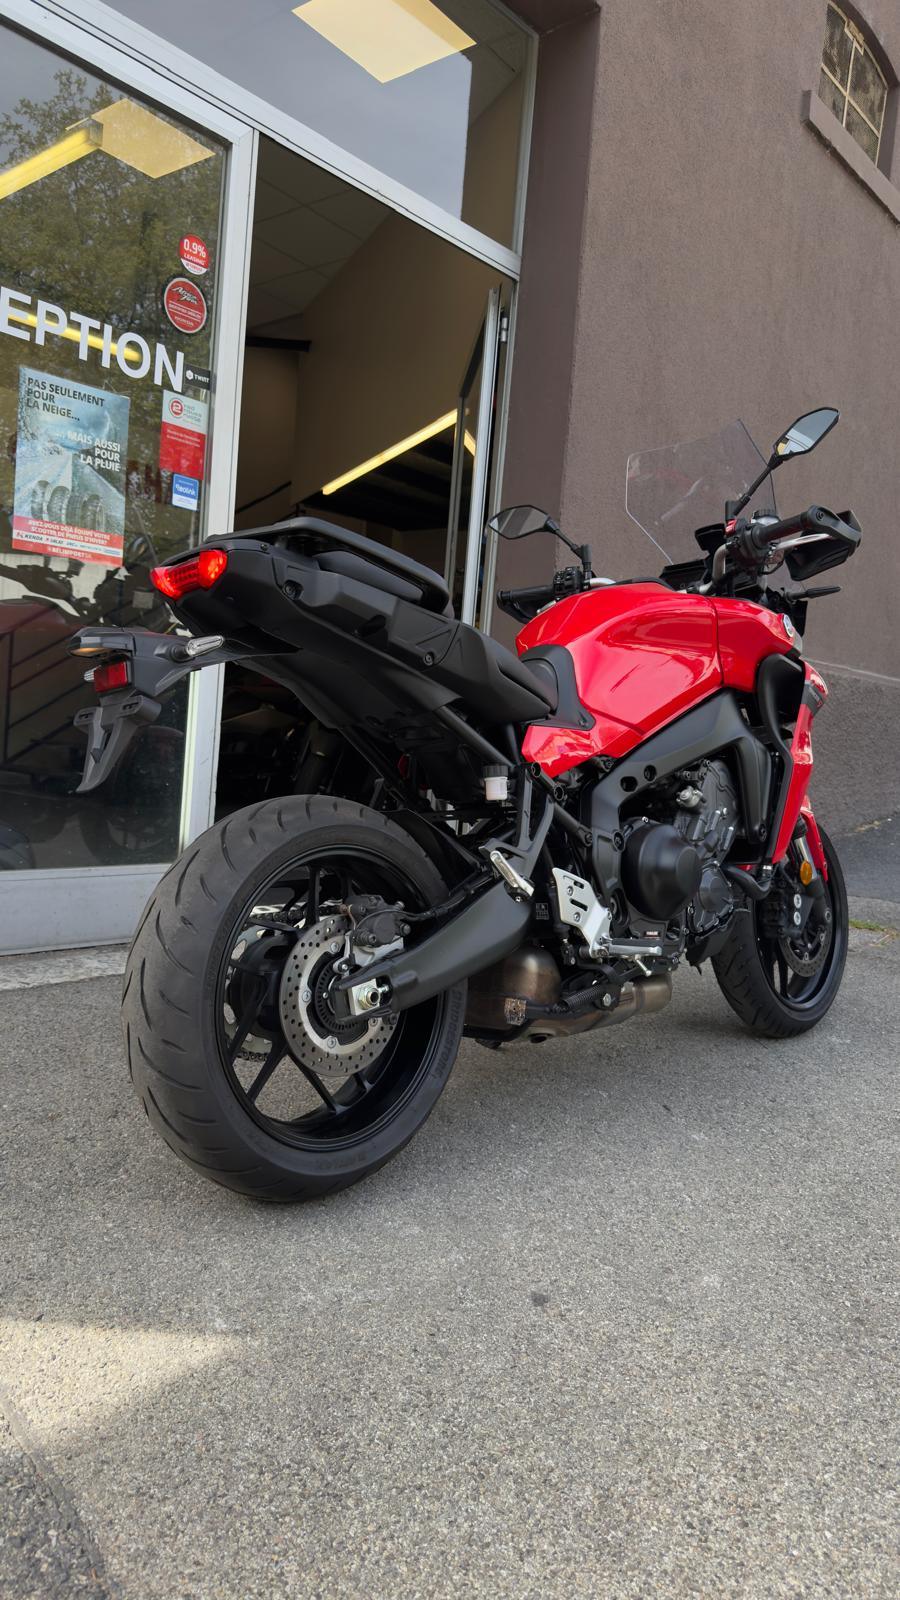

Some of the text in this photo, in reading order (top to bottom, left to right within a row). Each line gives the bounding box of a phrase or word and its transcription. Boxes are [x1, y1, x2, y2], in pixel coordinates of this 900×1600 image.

[184, 239, 206, 257] 0.9%
[184, 253, 205, 265] LEASING
[0, 286, 184, 393] EPTION
[26, 388, 55, 403] POUR
[28, 377, 105, 407] PAS SEULEMENT
[26, 398, 80, 421] LA NEIGE...
[67, 431, 120, 452] MAIS AUSSI
[80, 454, 120, 472] LA PLUIE
[95, 448, 120, 462] POUR
